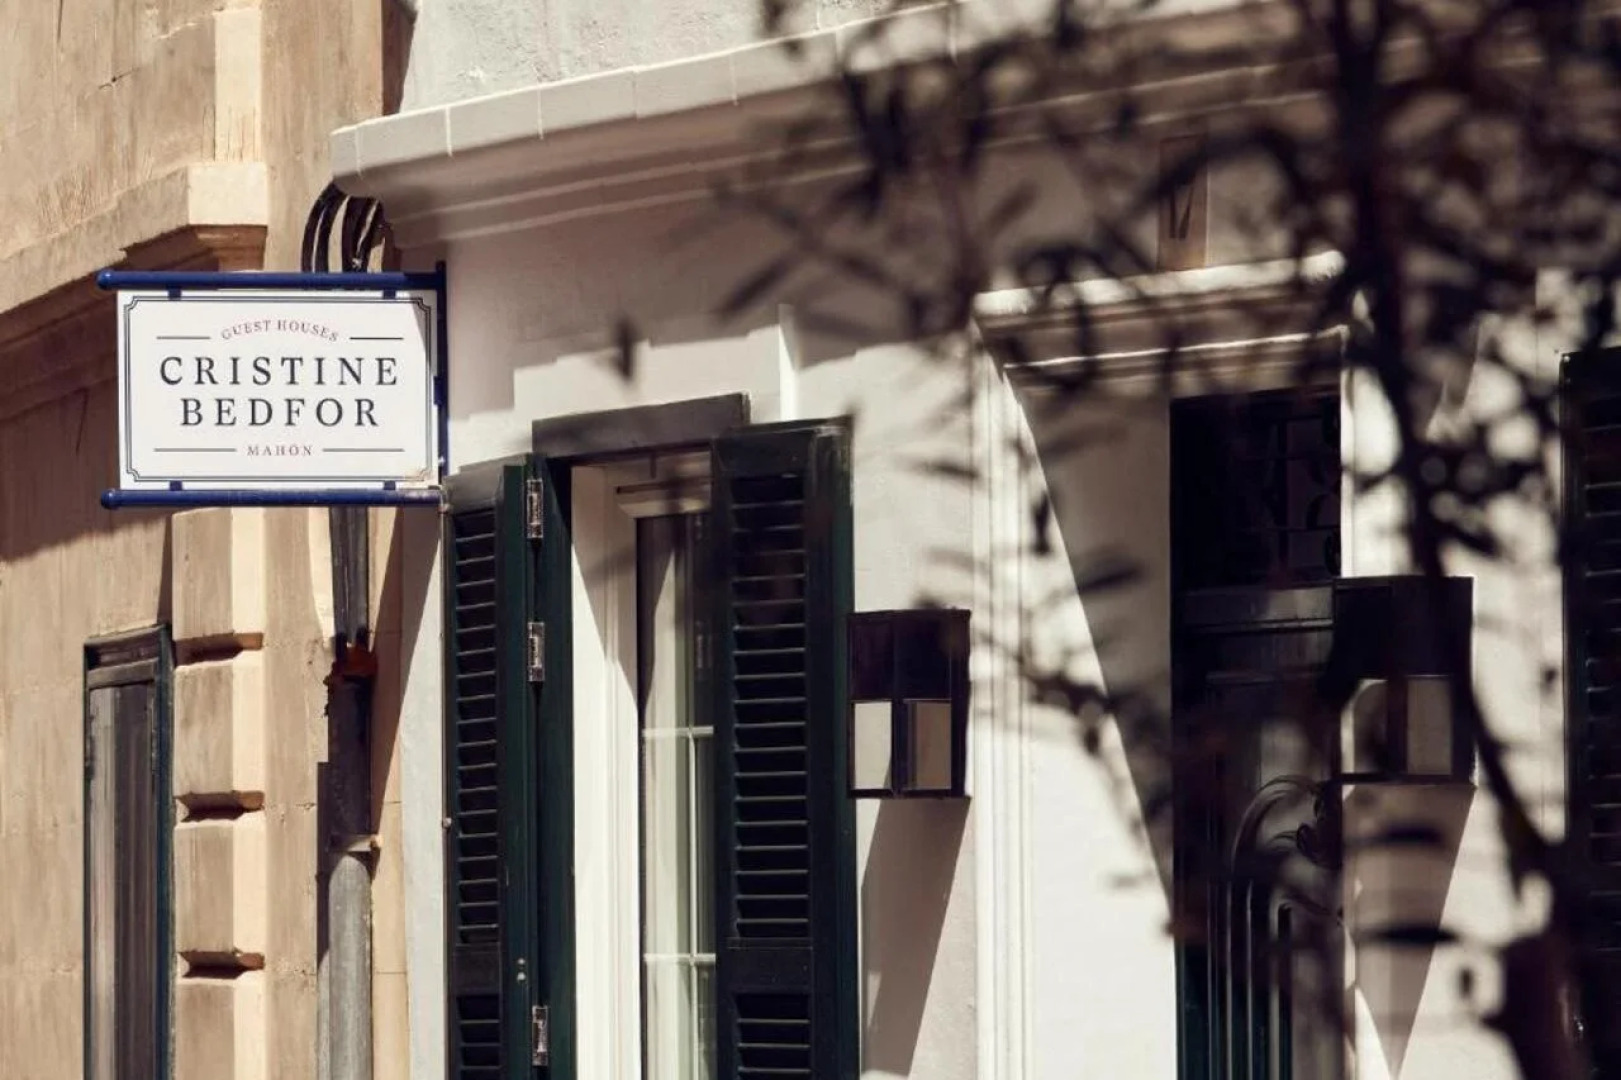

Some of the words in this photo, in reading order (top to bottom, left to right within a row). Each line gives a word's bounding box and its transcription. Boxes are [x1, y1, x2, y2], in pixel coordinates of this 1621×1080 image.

[221, 319, 272, 341] GUEST
[277, 318, 339, 343] HOUSES
[159, 356, 398, 386] CRISTINE
[181, 398, 379, 427] BEDFOR
